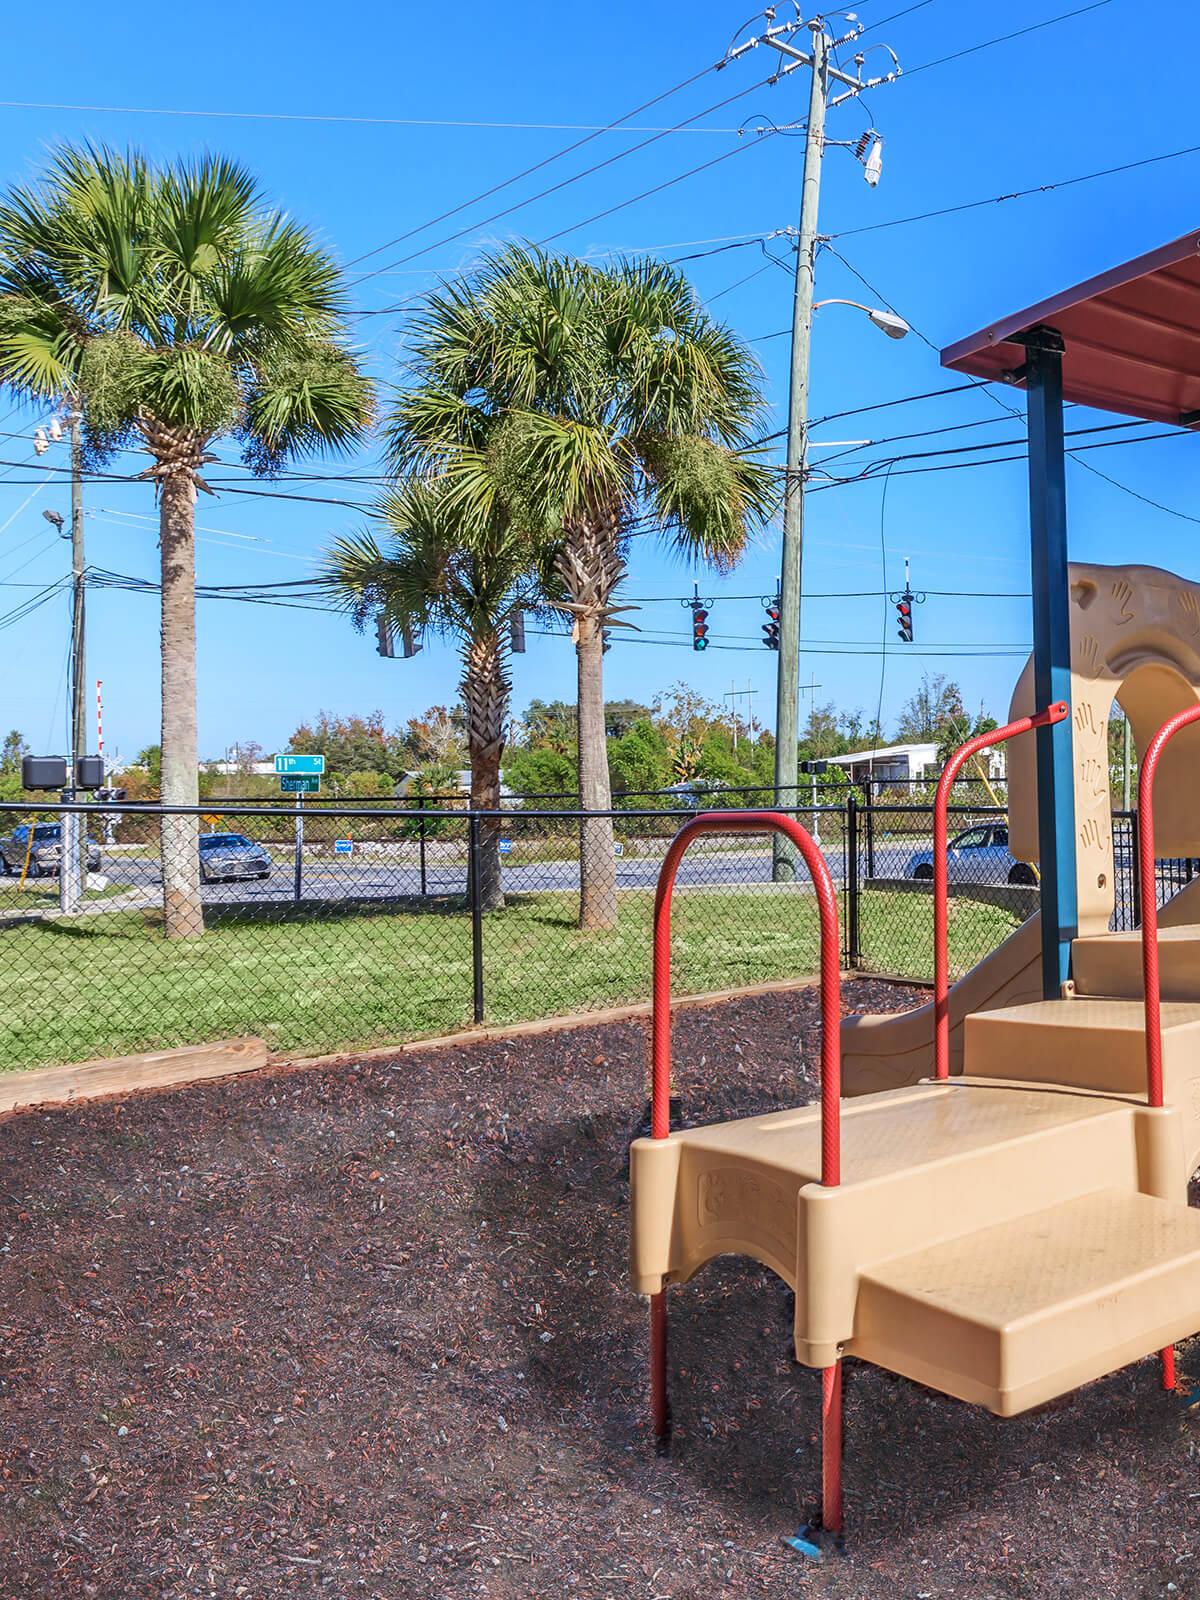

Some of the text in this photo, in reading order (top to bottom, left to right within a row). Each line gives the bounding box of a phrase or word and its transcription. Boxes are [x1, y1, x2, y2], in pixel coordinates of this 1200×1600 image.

[277, 757, 321, 771] 11th St
[282, 777, 310, 791] Sherman
